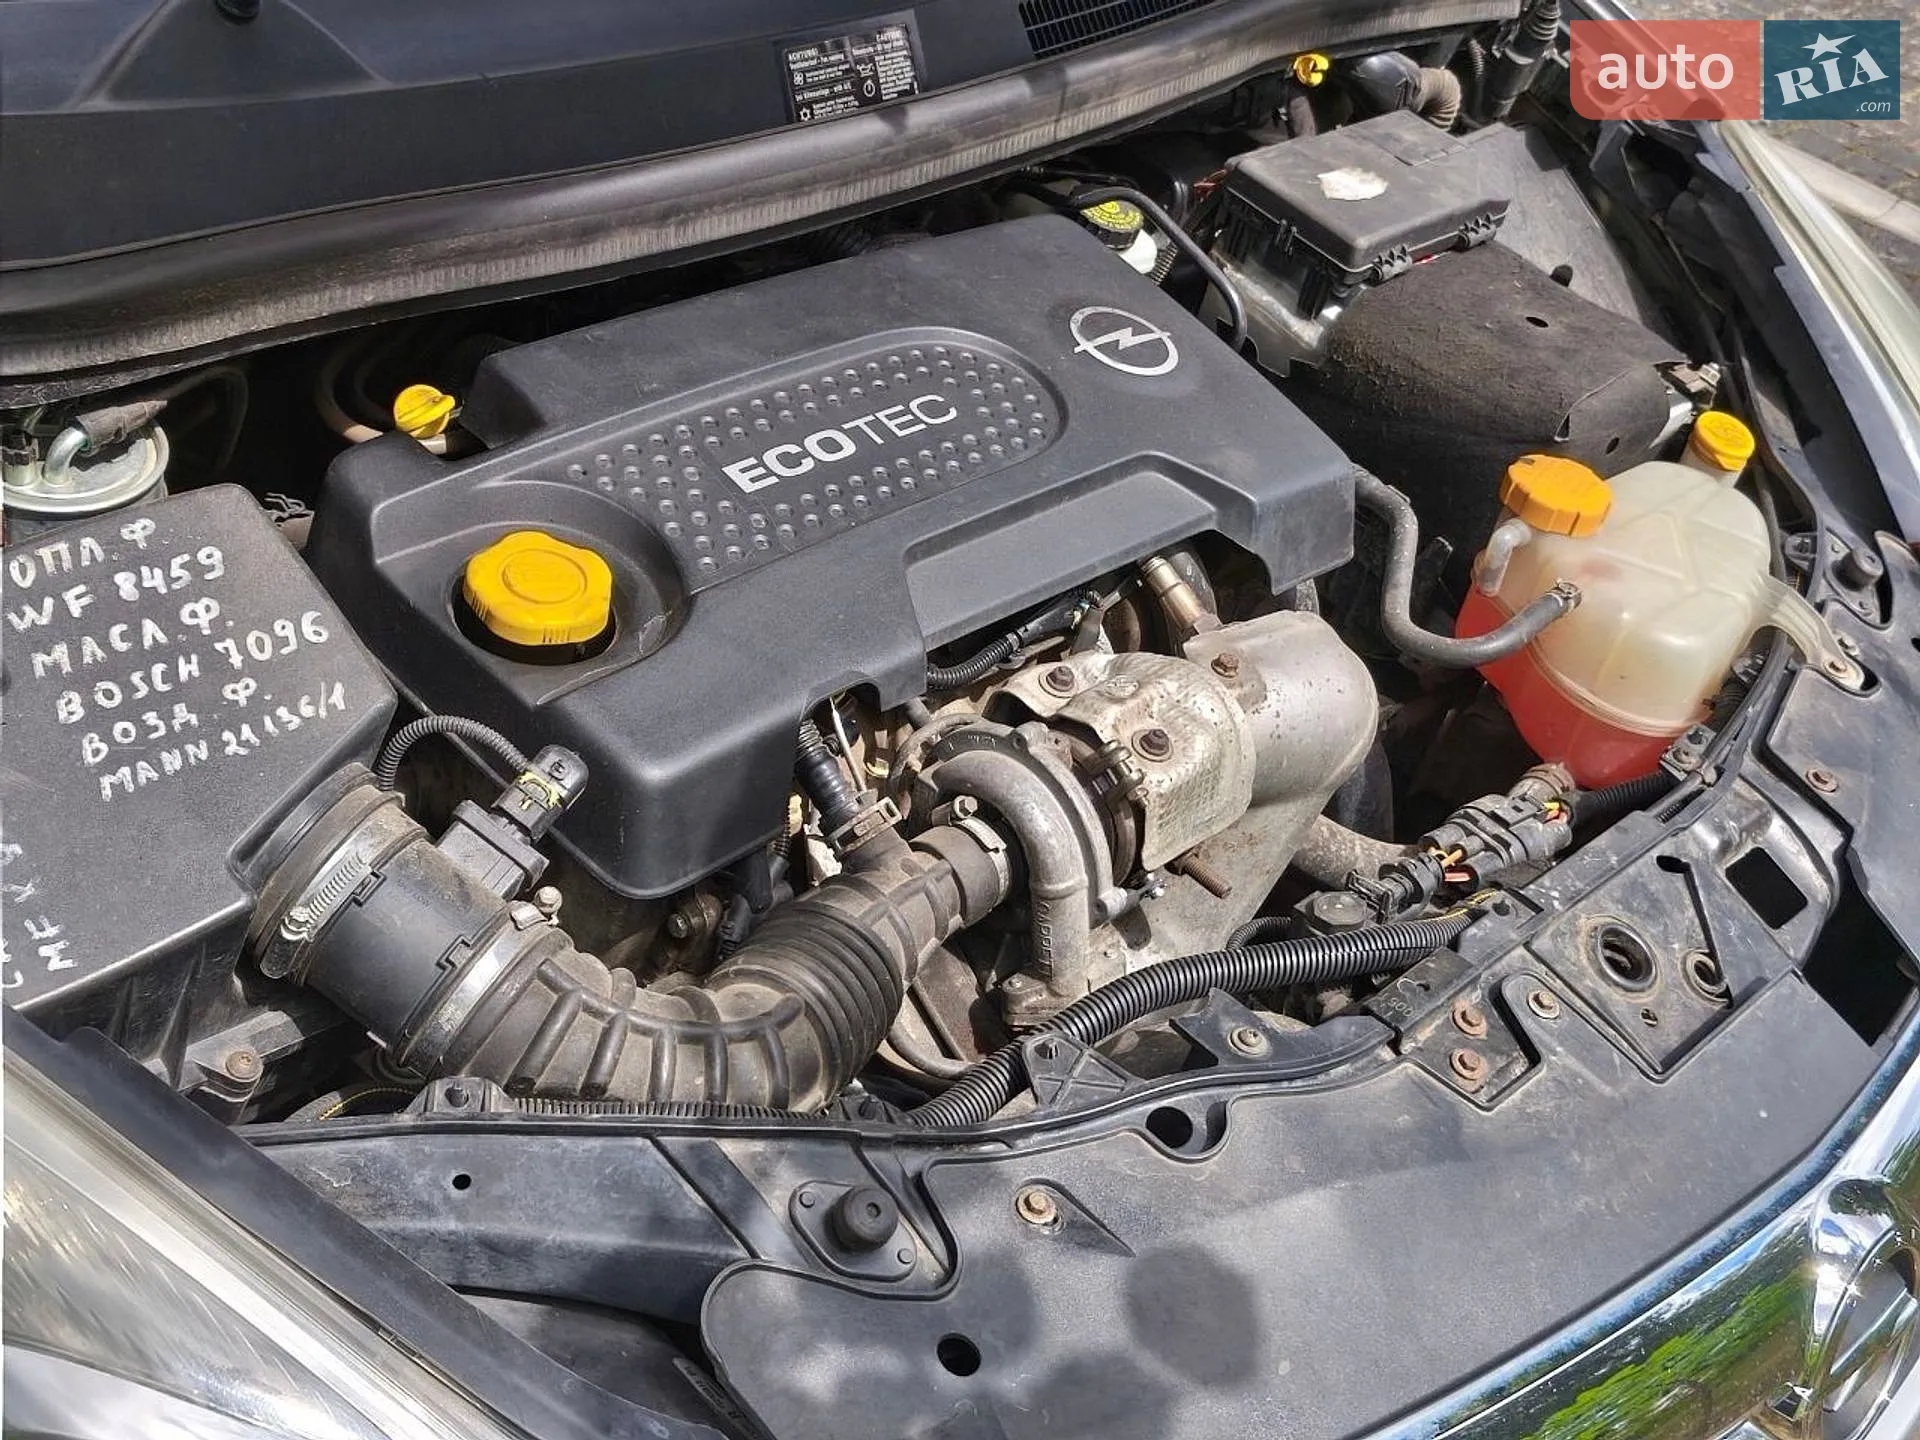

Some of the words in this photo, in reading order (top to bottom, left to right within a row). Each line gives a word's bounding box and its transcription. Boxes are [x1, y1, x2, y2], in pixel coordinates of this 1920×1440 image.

[721, 395, 957, 493] ECOTEC
[7, 584, 97, 632] WF
[113, 546, 225, 601] 8459
[56, 653, 200, 724] BOSCH
[214, 611, 329, 671] 7096
[100, 740, 208, 801] MANN
